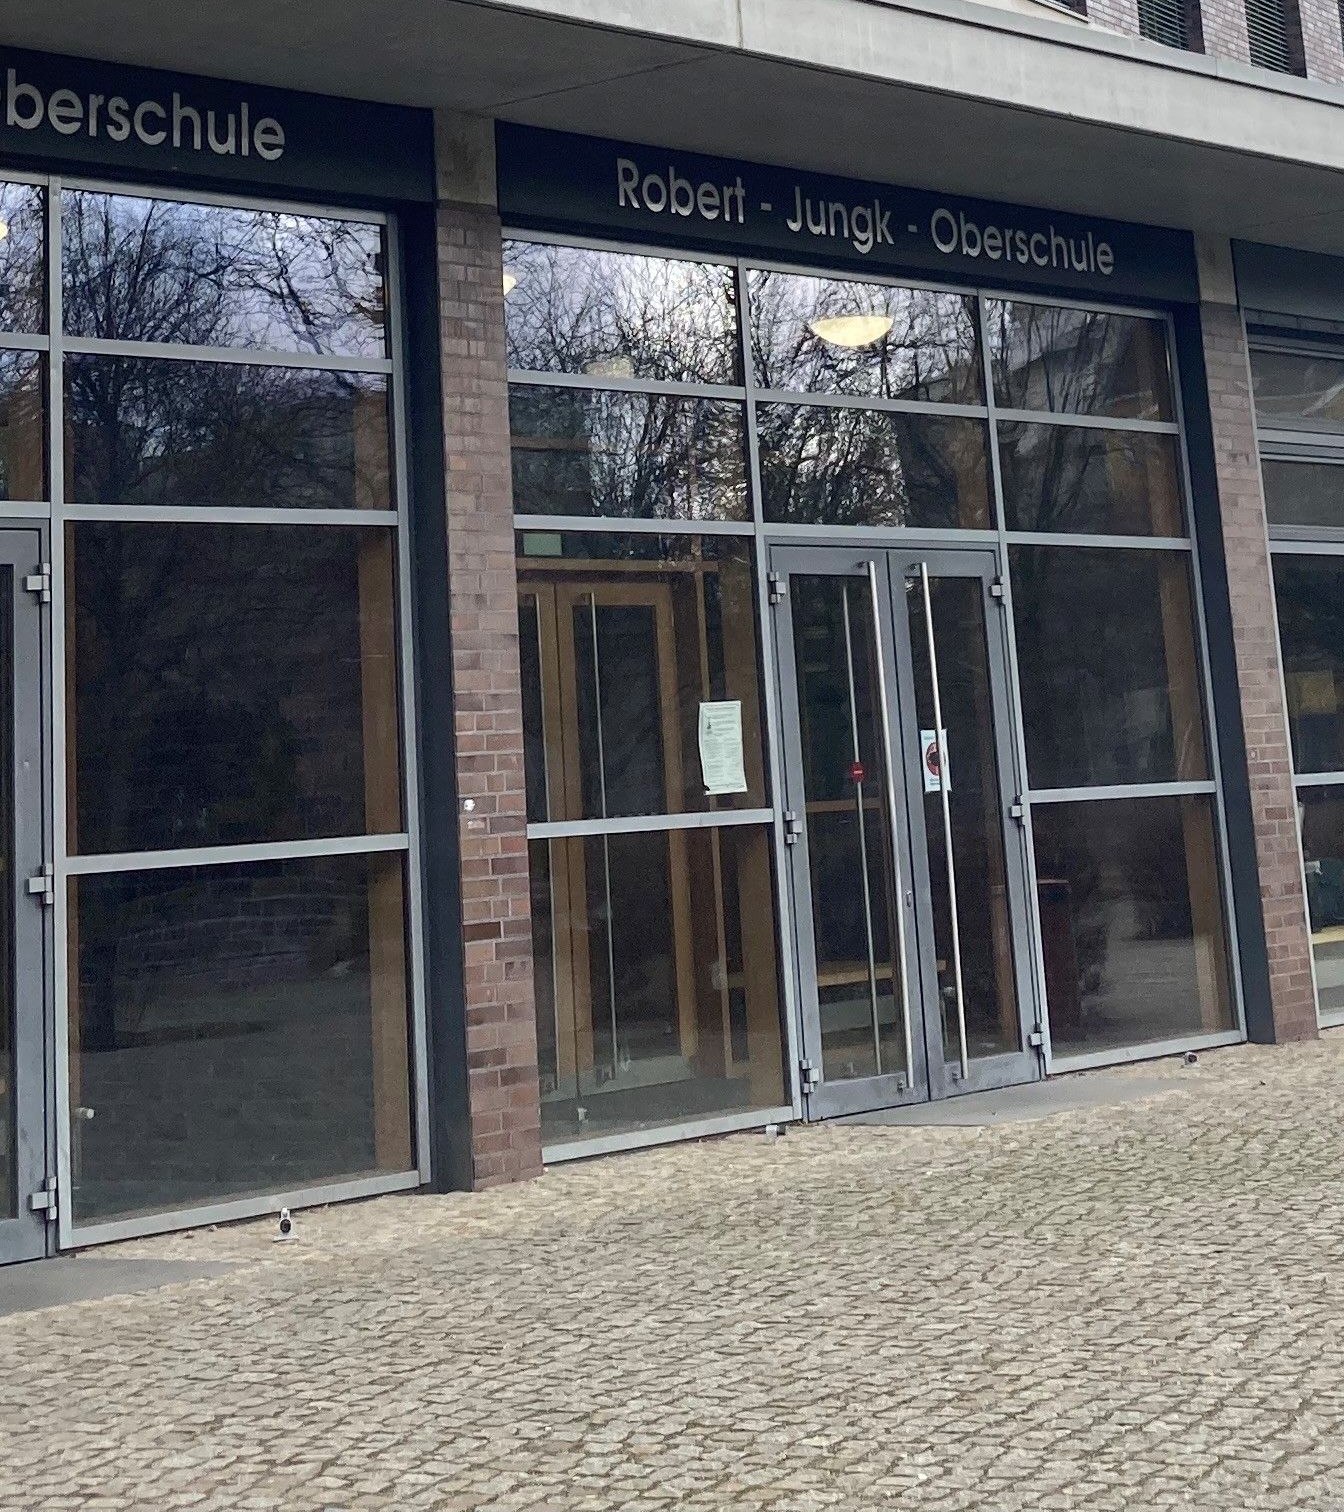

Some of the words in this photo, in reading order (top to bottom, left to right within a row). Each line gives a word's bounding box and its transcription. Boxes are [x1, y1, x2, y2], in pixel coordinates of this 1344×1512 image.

[617, 158, 746, 224] Robert
[786, 186, 895, 254] Jungk
[930, 208, 1114, 275] Oberschule
